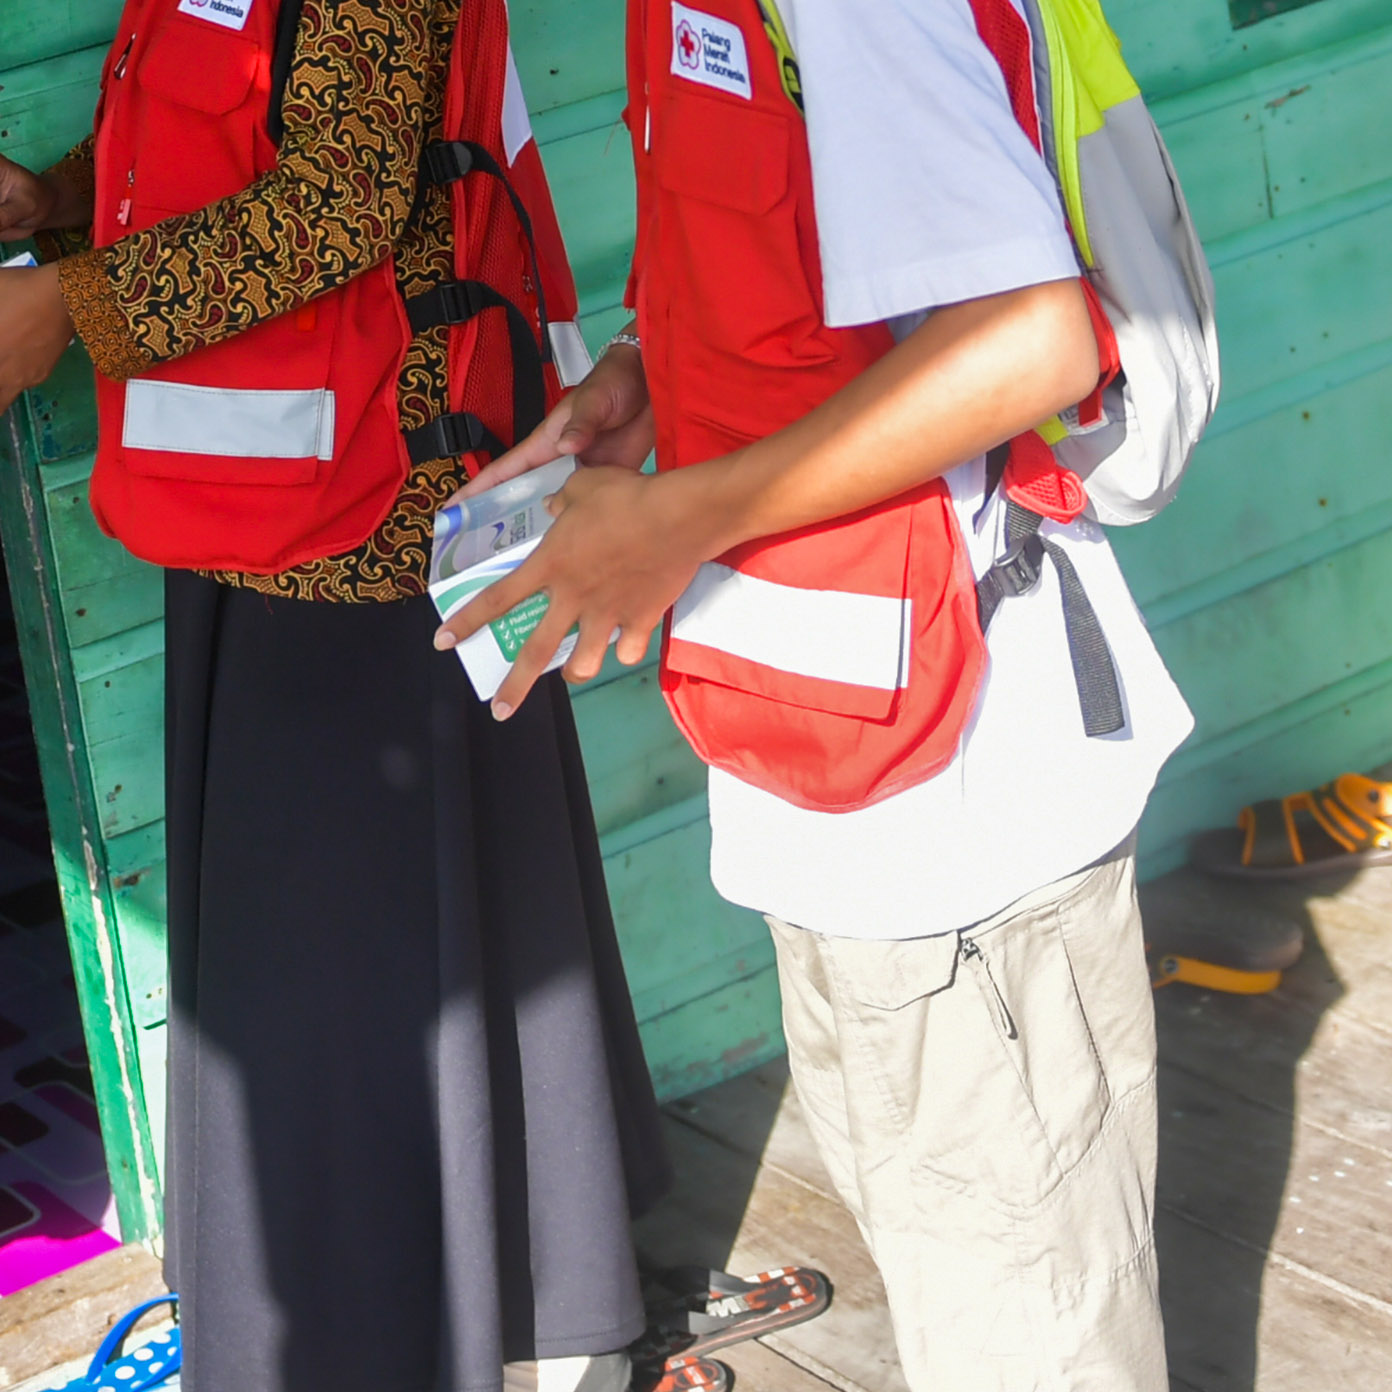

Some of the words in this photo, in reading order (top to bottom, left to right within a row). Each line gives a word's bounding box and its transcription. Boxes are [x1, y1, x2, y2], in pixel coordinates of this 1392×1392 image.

[210, 0, 244, 18] Indonesia
[701, 28, 731, 52] Palang
[703, 44, 730, 64] Merah
[704, 60, 746, 83] Indonesia
[509, 611, 528, 626] Fluid
